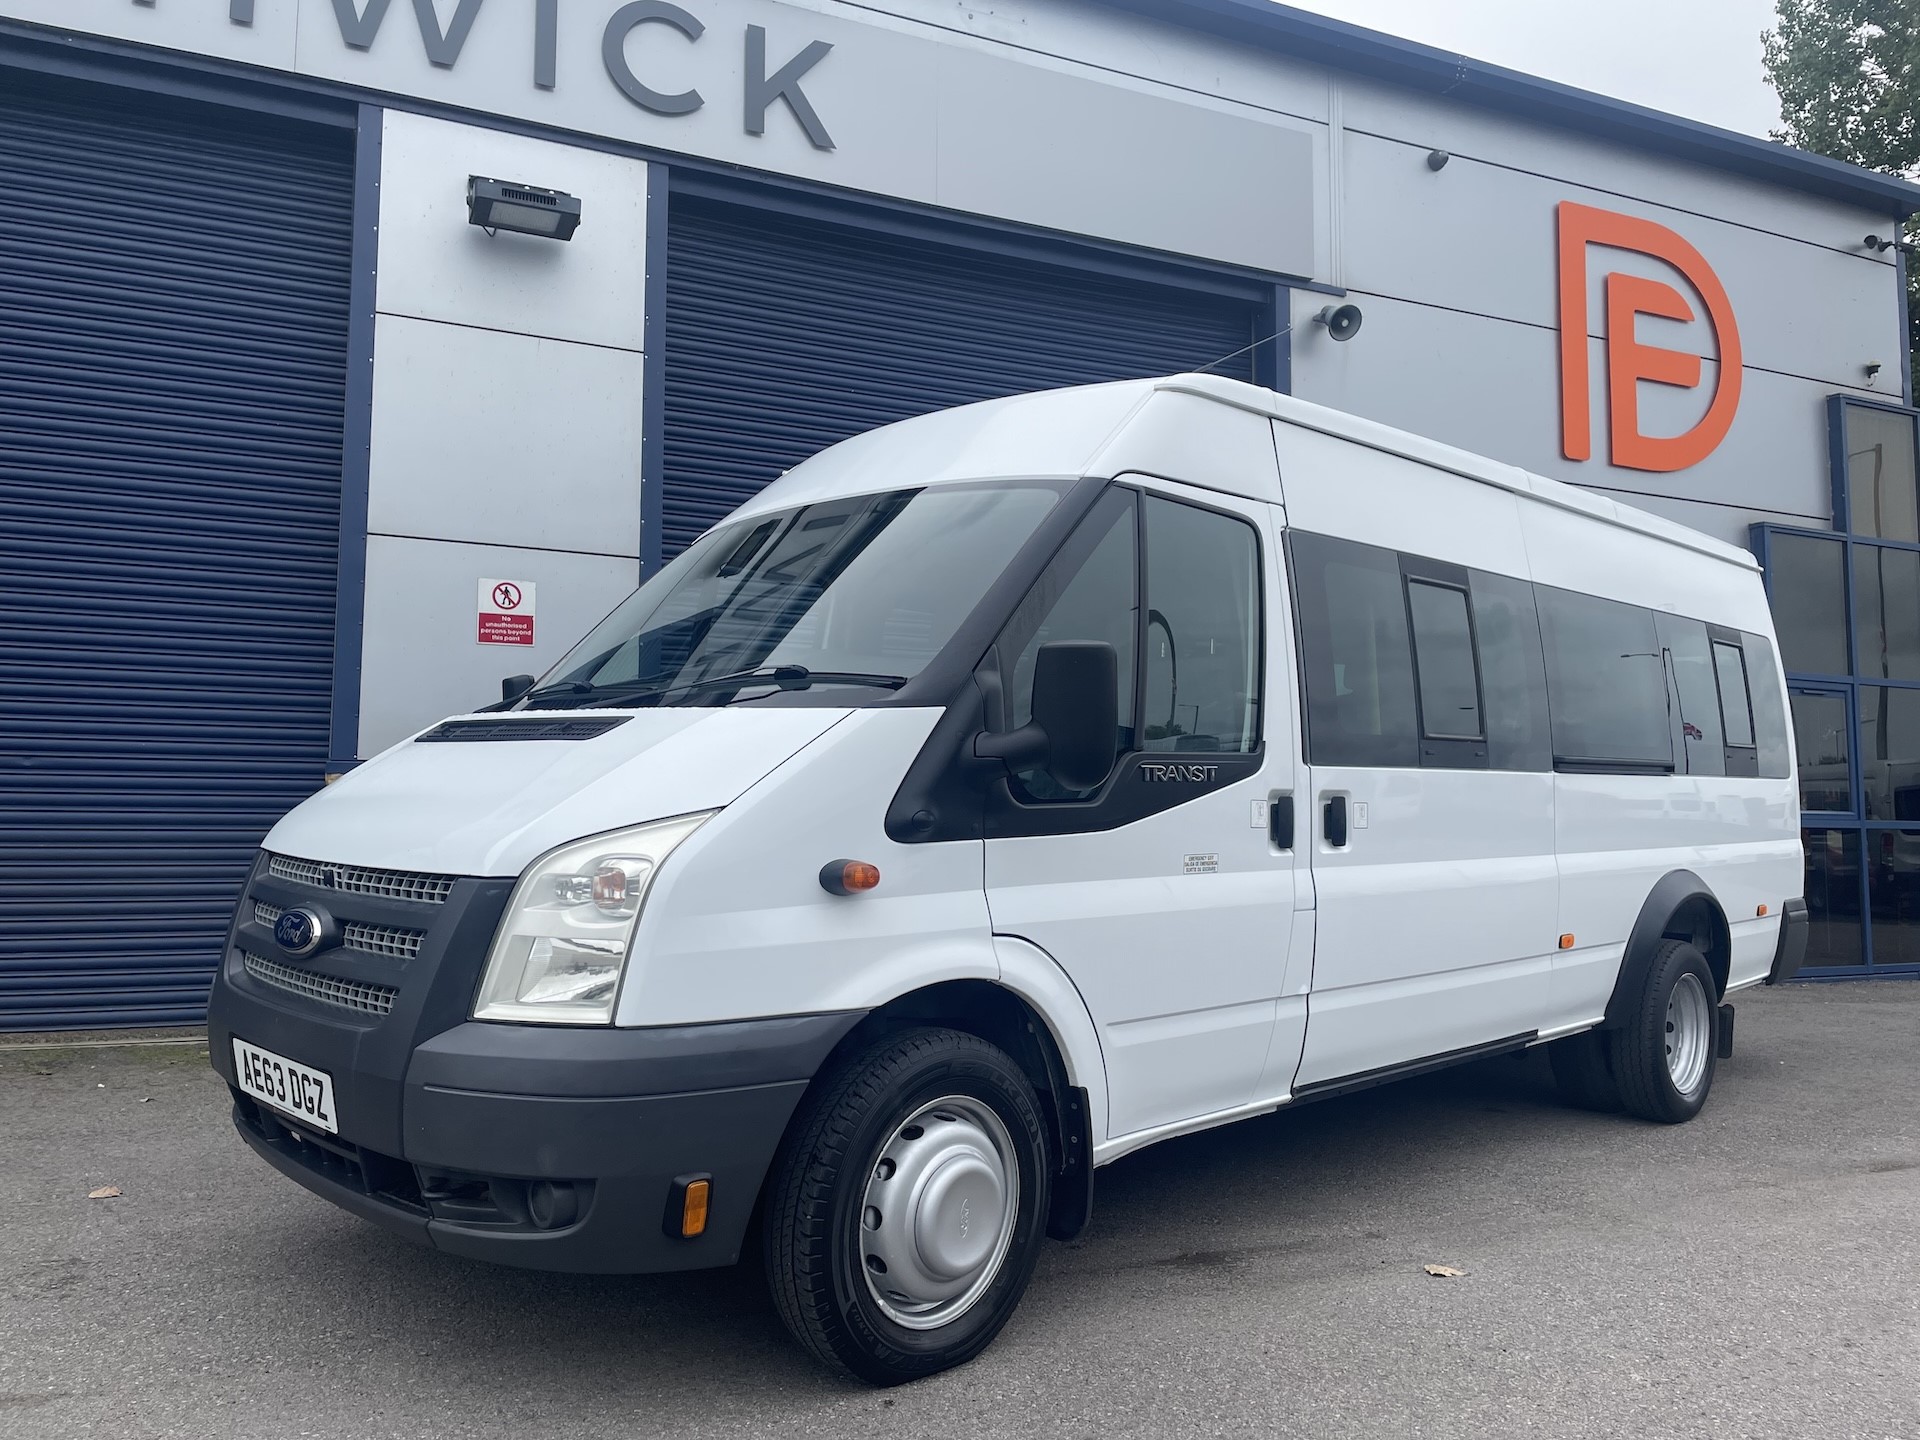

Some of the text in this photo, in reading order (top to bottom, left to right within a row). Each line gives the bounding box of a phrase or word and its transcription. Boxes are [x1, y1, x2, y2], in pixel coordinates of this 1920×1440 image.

[1140, 764, 1218, 781] TRANSIT
[277, 914, 305, 944] Ford
[243, 1048, 328, 1122] AE63 DGZ
